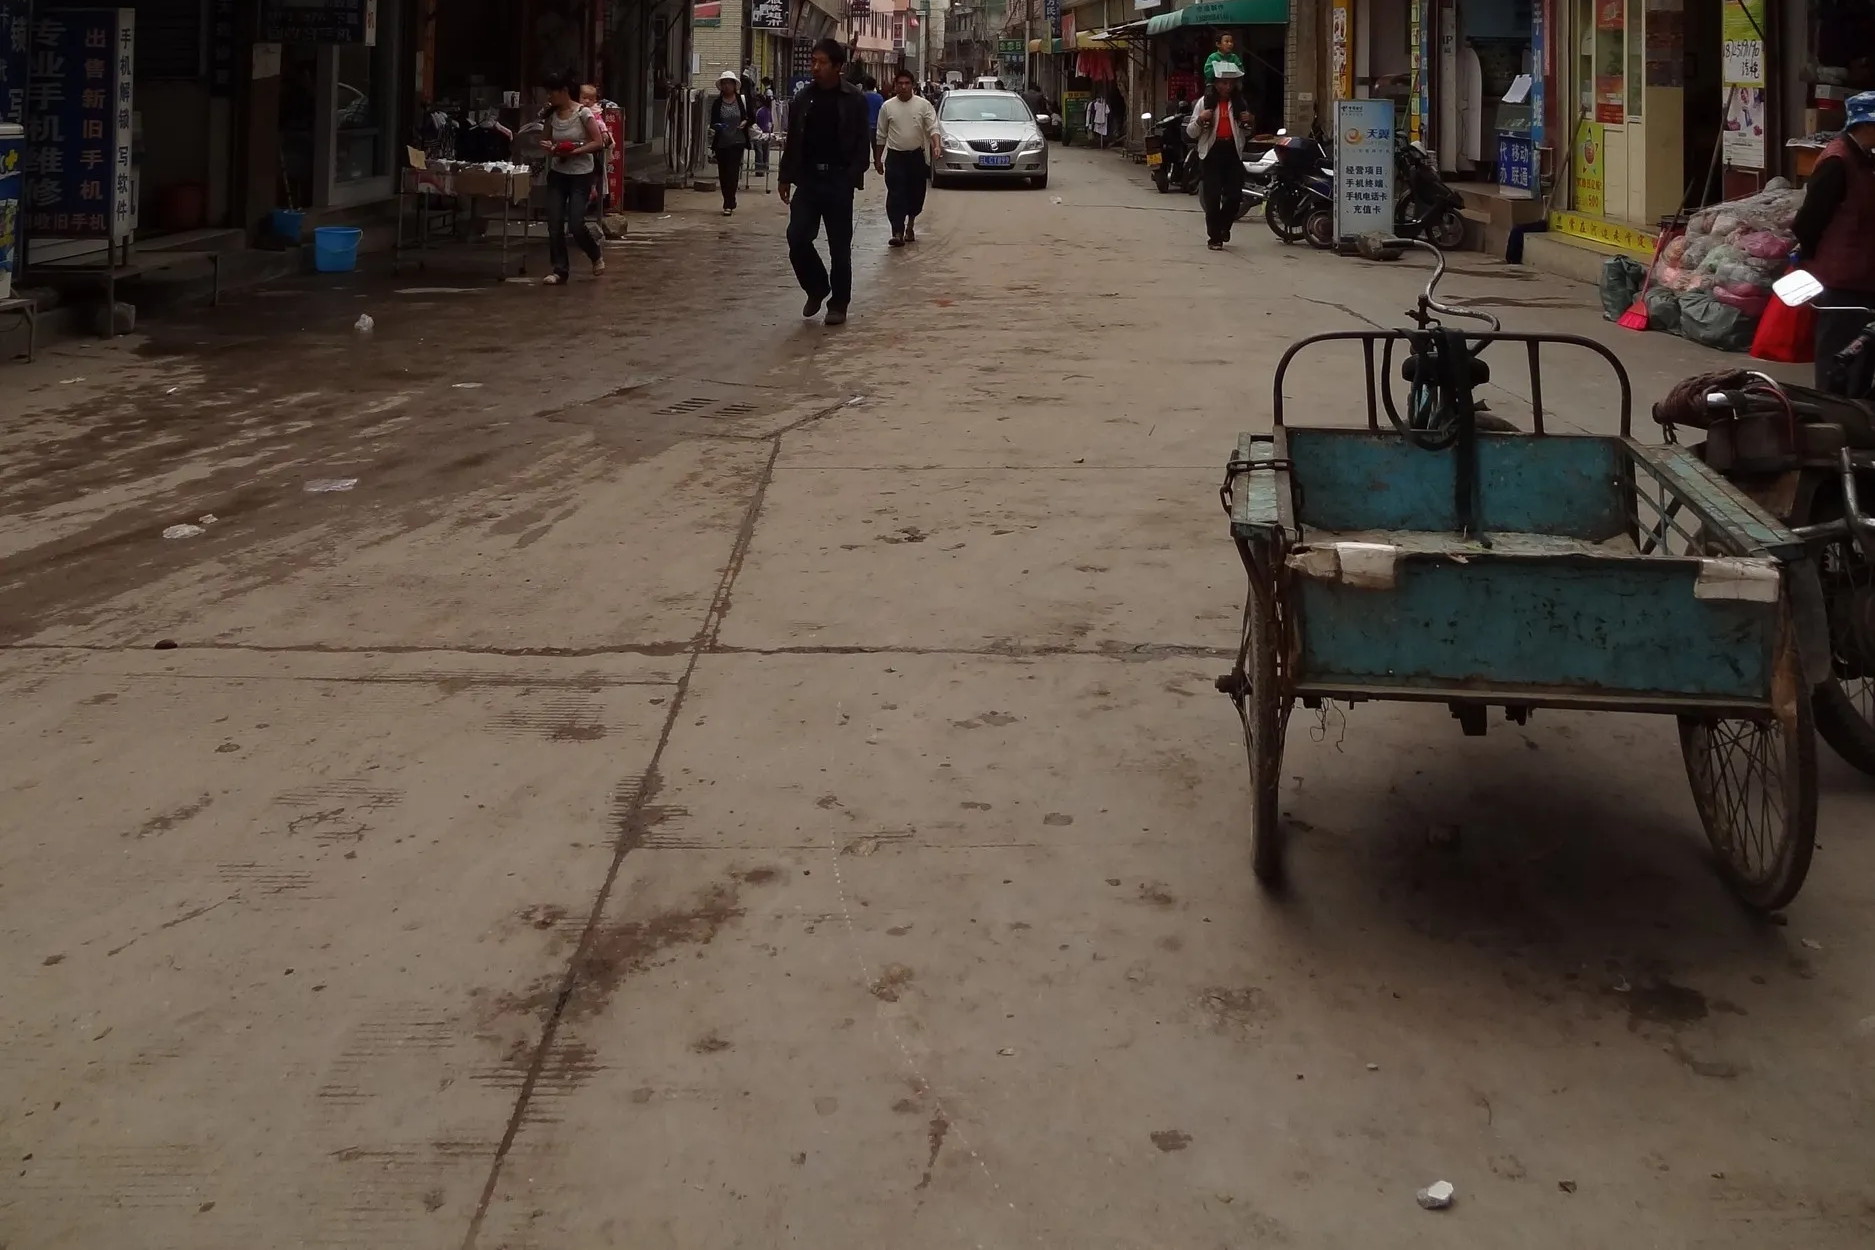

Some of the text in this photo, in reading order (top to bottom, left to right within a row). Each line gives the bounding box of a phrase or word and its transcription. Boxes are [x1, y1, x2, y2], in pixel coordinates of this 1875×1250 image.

[27, 18, 67, 207] 专业手机维修
[79, 28, 108, 201] 出售新旧手机
[119, 29, 131, 130] 手机解锁
[1367, 128, 1391, 140] 天翼
[117, 146, 129, 222] 写软件
[1345, 191, 1388, 202] 手机电话卡
